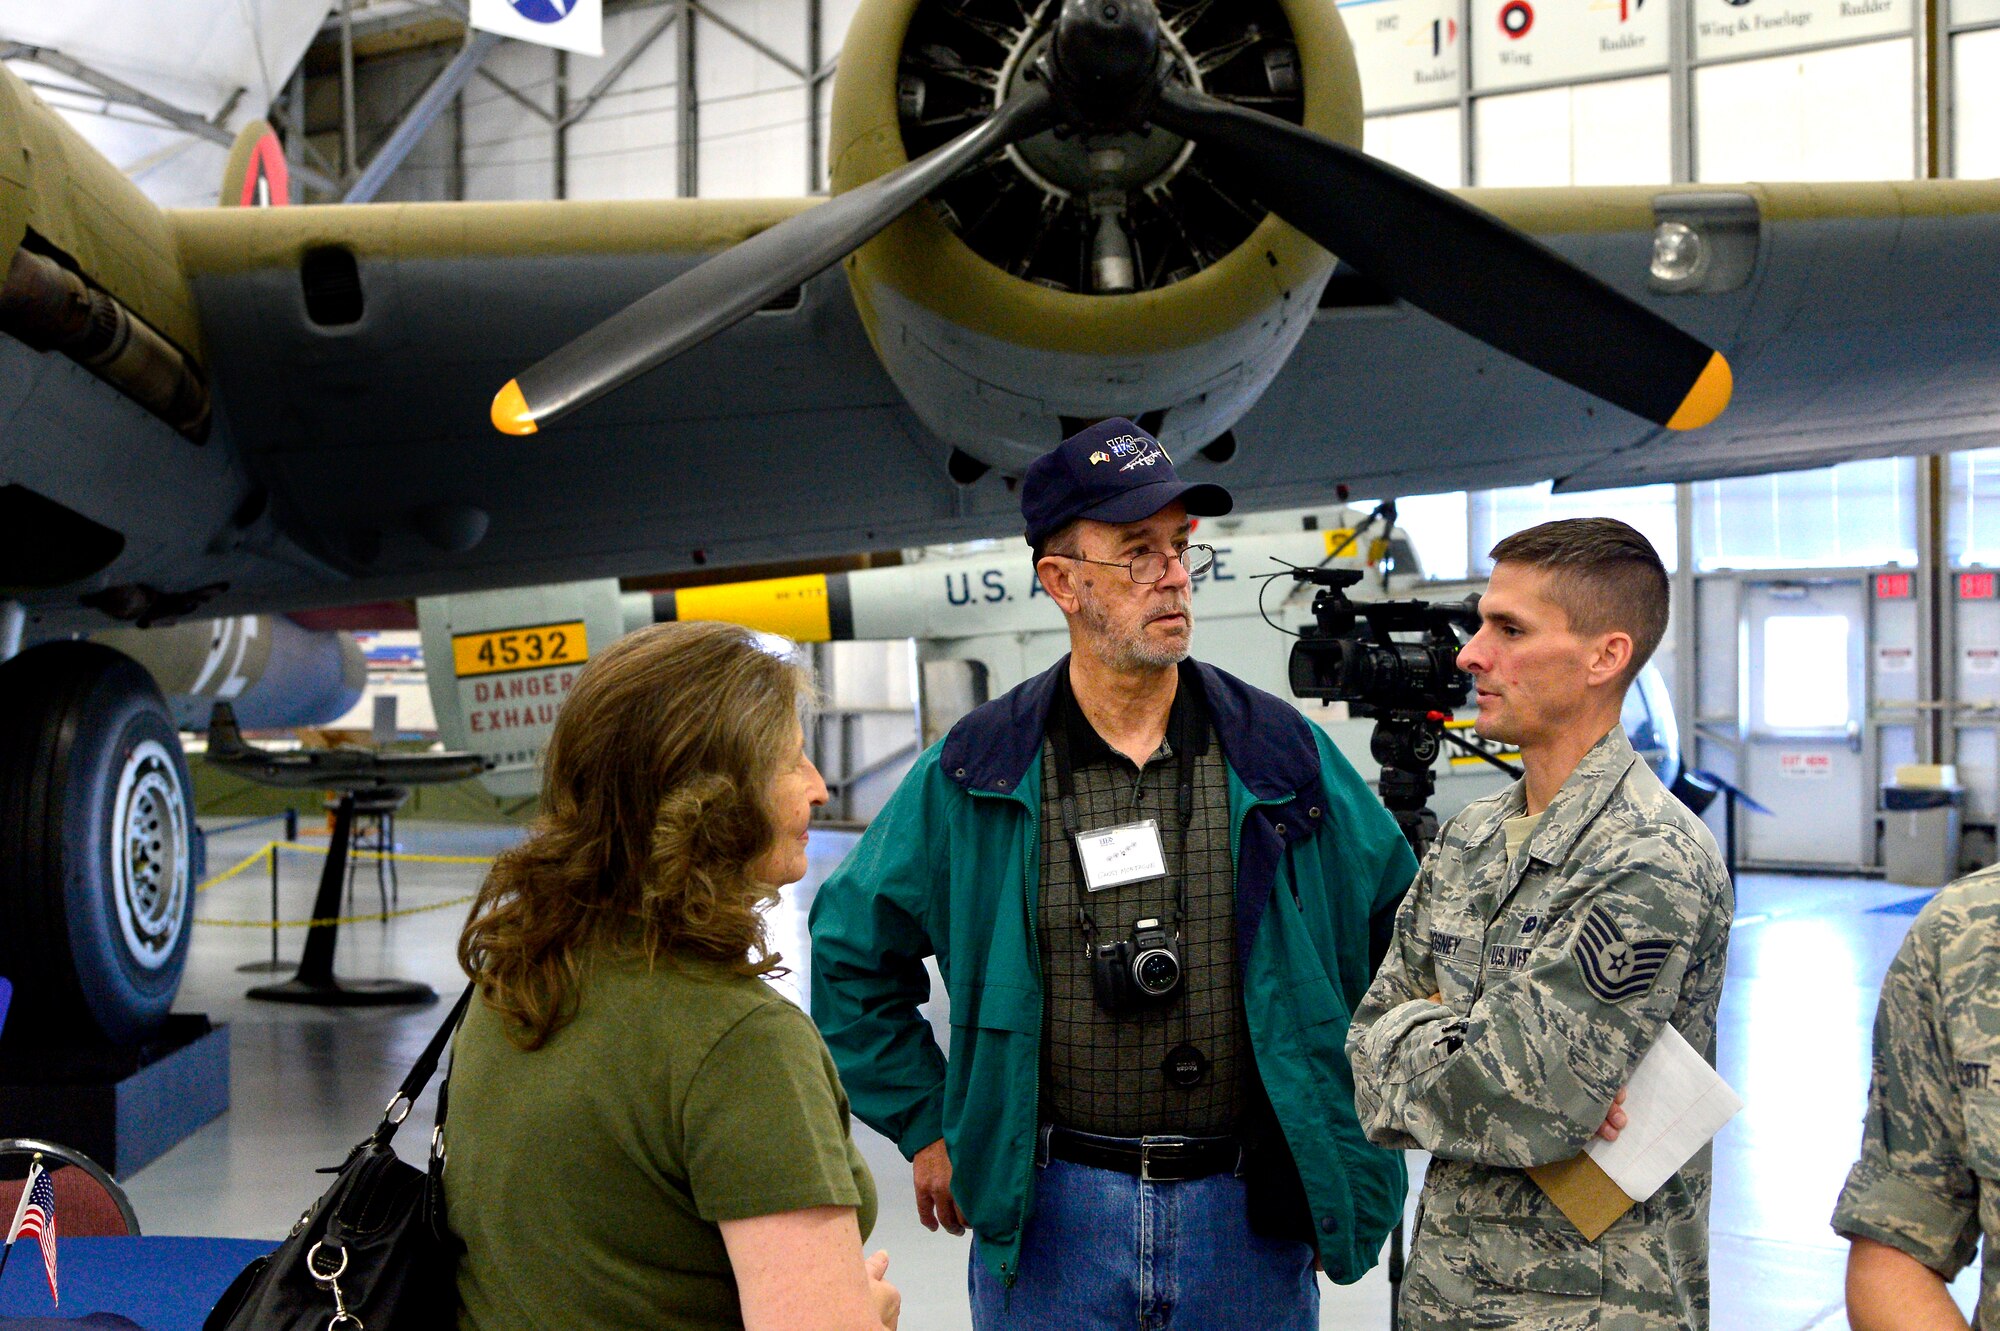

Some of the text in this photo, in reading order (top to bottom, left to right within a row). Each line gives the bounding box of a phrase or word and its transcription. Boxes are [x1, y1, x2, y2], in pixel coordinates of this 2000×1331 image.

[1840, 1, 1893, 17] Rudder
[1700, 12, 1811, 37] Wing & Fuselage
[1600, 34, 1646, 52] Rudder
[1499, 50, 1532, 66] Wing
[1413, 67, 1457, 84] Rudder
[946, 569, 1013, 606] U.S.
[477, 631, 568, 667] 4532
[474, 673, 574, 703] DANGER
